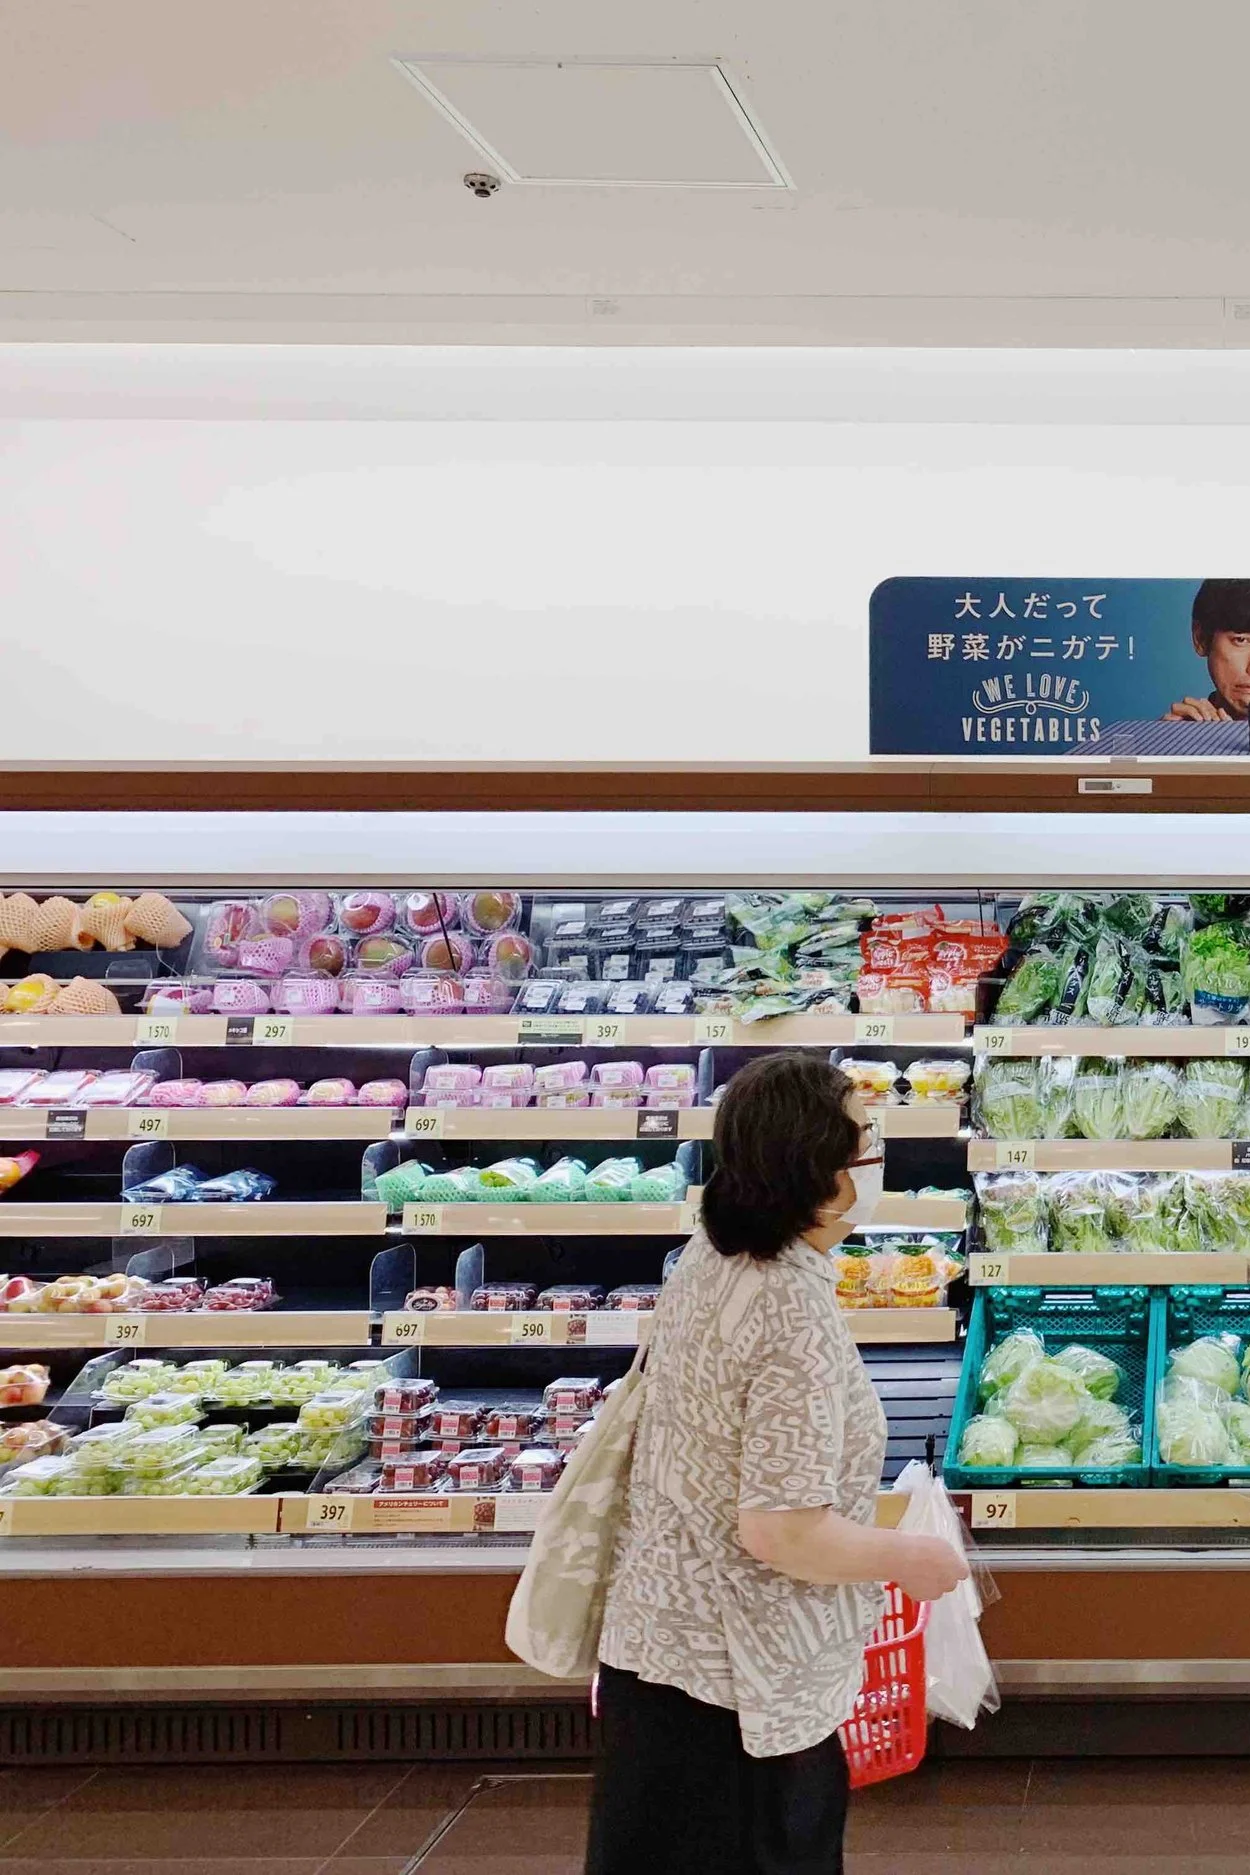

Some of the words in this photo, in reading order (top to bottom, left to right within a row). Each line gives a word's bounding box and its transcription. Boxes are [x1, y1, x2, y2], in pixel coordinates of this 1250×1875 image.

[954, 592, 1108, 620] 大人だって
[926, 632, 1135, 662] 野菜がニガテ！
[981, 673, 1017, 704] WE
[1026, 672, 1081, 705] LOVE
[962, 716, 1101, 742] VEGETABLES
[264, 1025, 286, 1038] 297
[597, 1025, 619, 1038] 397
[706, 1025, 726, 1038] 157
[865, 1024, 886, 1037] 297
[985, 1035, 1005, 1049] 197
[139, 1118, 161, 1132] 497
[415, 1118, 437, 1131] 697
[1007, 1150, 1028, 1163] 147
[131, 1214, 154, 1228] 697
[981, 1264, 1002, 1278] 127
[116, 1325, 139, 1339] 397
[395, 1323, 418, 1337] 697
[521, 1323, 544, 1337] 590
[320, 1504, 345, 1521] 397
[986, 1503, 1008, 1519] 97
